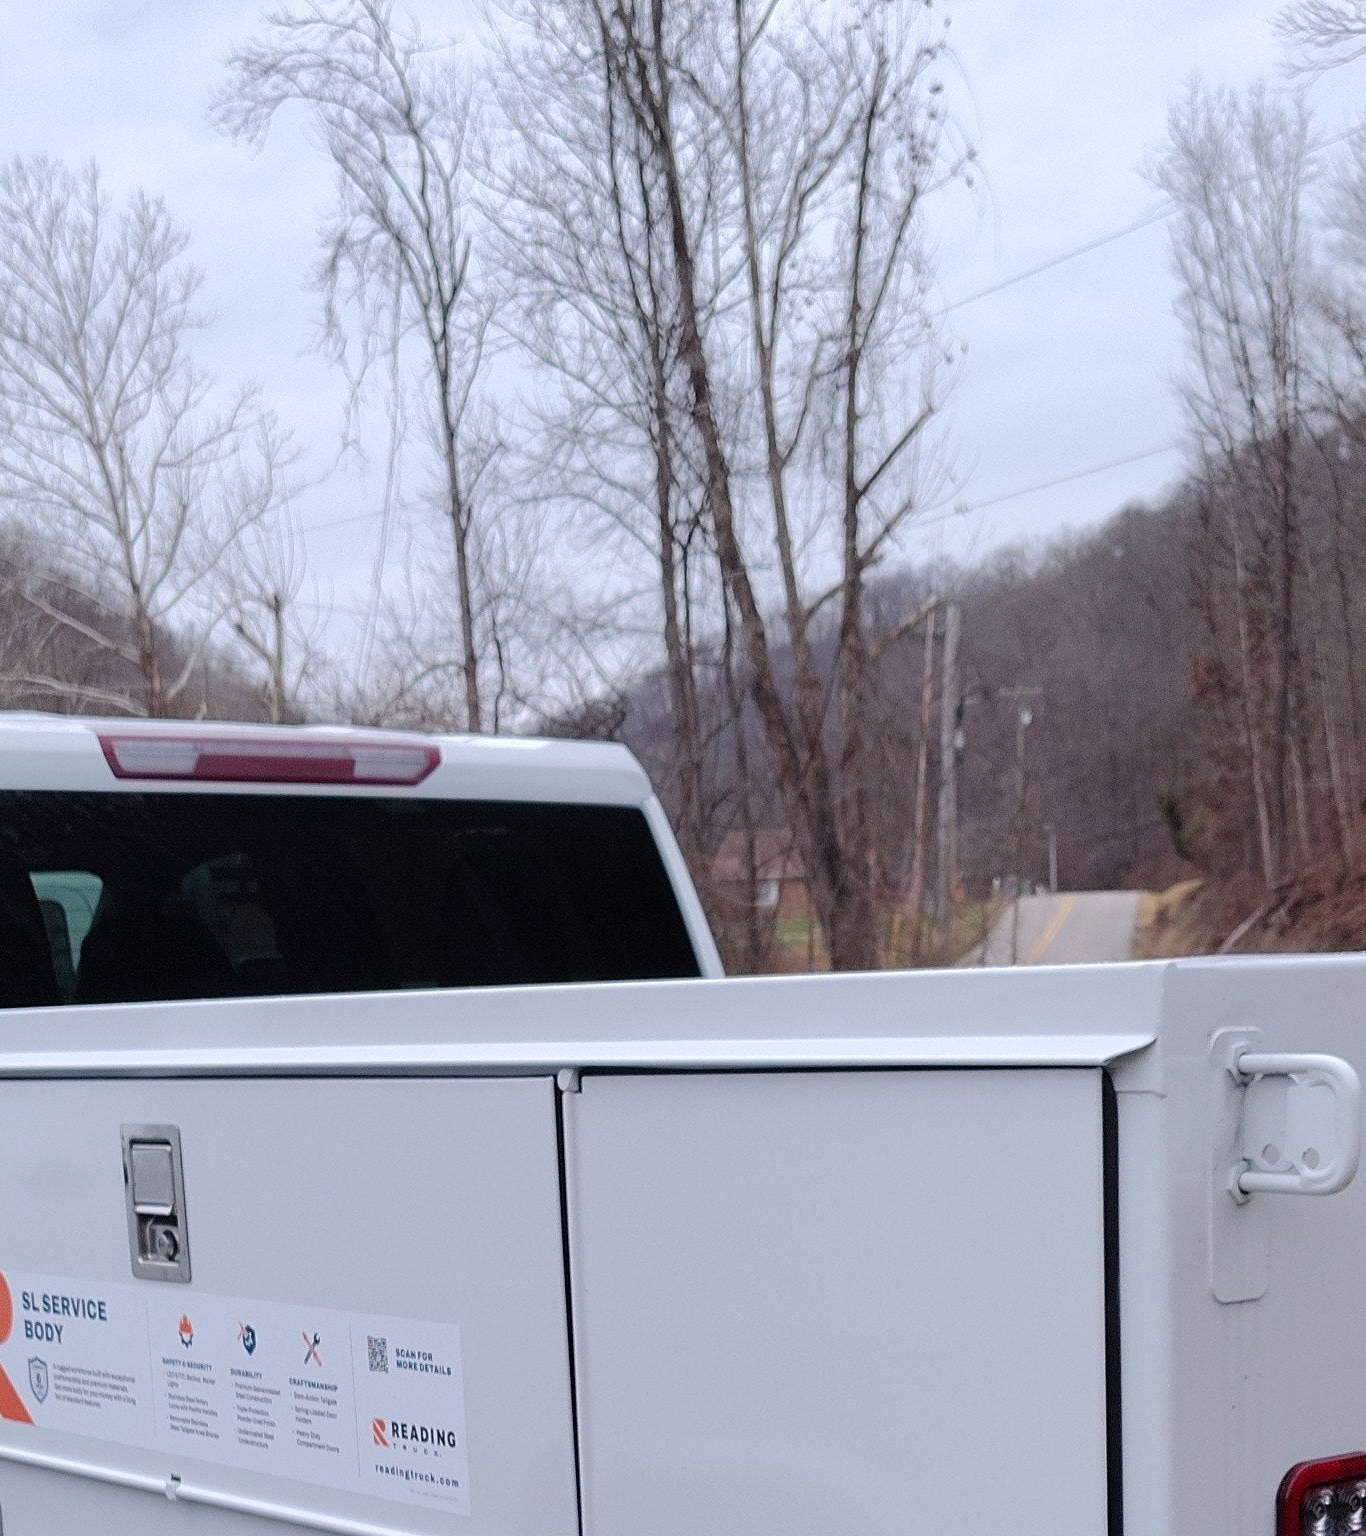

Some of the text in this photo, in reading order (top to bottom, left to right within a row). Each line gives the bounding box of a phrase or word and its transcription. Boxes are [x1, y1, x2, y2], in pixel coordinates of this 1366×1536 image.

[22, 1291, 107, 1321] SL SERVICE
[25, 1319, 64, 1343] BODY
[395, 1348, 433, 1361] SCAN FOR
[397, 1360, 451, 1376] MORE DETAILS
[392, 1421, 456, 1448] READING
[375, 1463, 459, 1489] readingtruck.com
